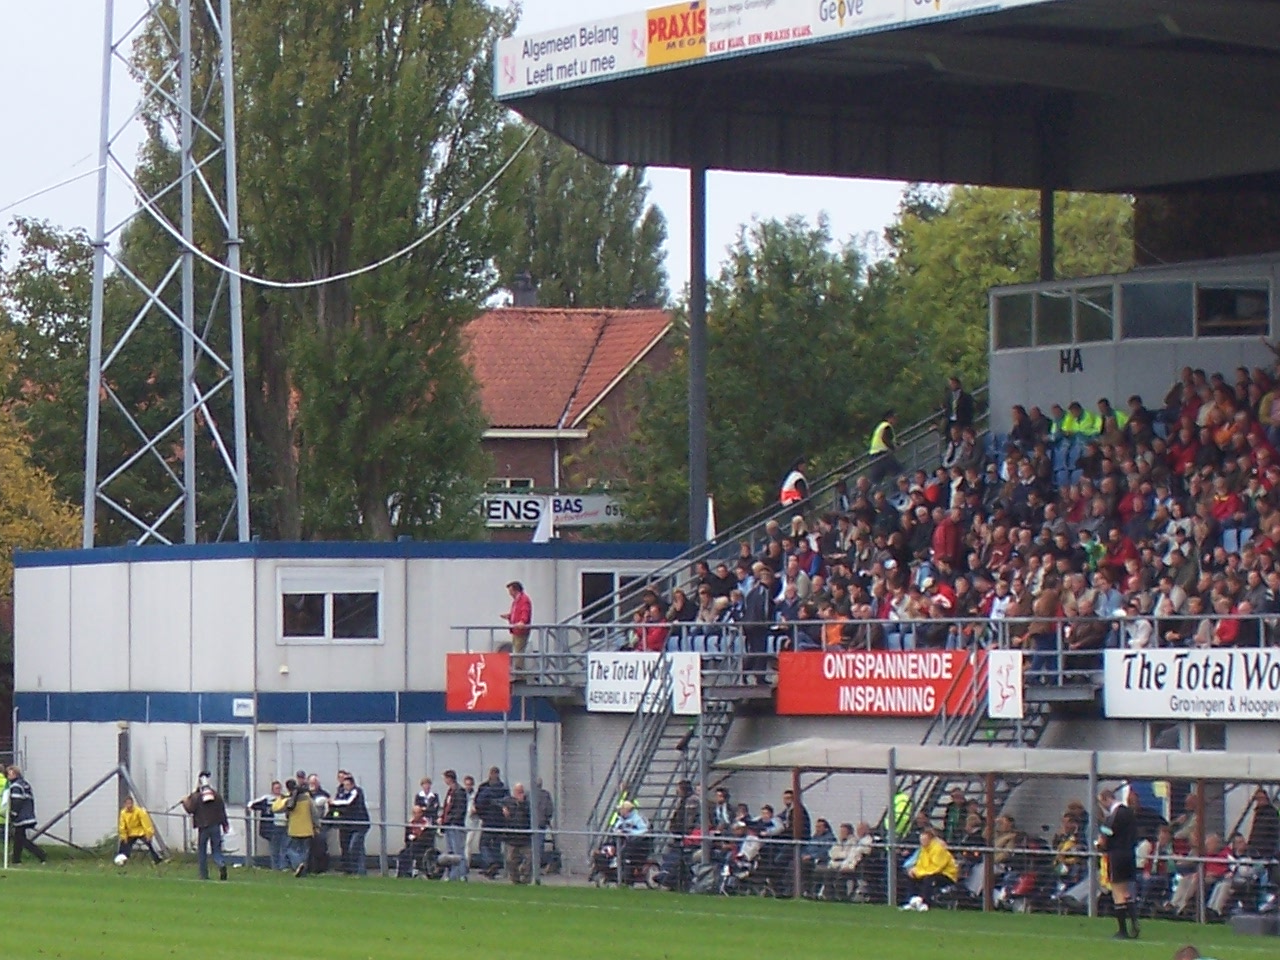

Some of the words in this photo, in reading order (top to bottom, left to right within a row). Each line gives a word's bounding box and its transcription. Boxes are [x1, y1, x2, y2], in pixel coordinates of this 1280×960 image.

[648, 9, 706, 44] PRAXIS
[764, 28, 790, 42] PRAXIS
[522, 32, 577, 60] Algemeen
[579, 25, 619, 47] Belang
[666, 35, 706, 51] MEGA
[526, 63, 554, 86] Leeft
[556, 59, 578, 81] met
[580, 60, 587, 76] u
[590, 54, 616, 71] mee
[1060, 348, 1083, 373] HA
[553, 498, 582, 513] BAS
[589, 660, 609, 680] The
[612, 660, 640, 681] Total
[823, 652, 953, 680] ONTSPANNENDE
[1124, 652, 1167, 690] The
[1175, 652, 1234, 690] Total
[839, 686, 936, 712] INSPANNING
[1170, 695, 1225, 716] Groningen
[1228, 696, 1236, 711] &
